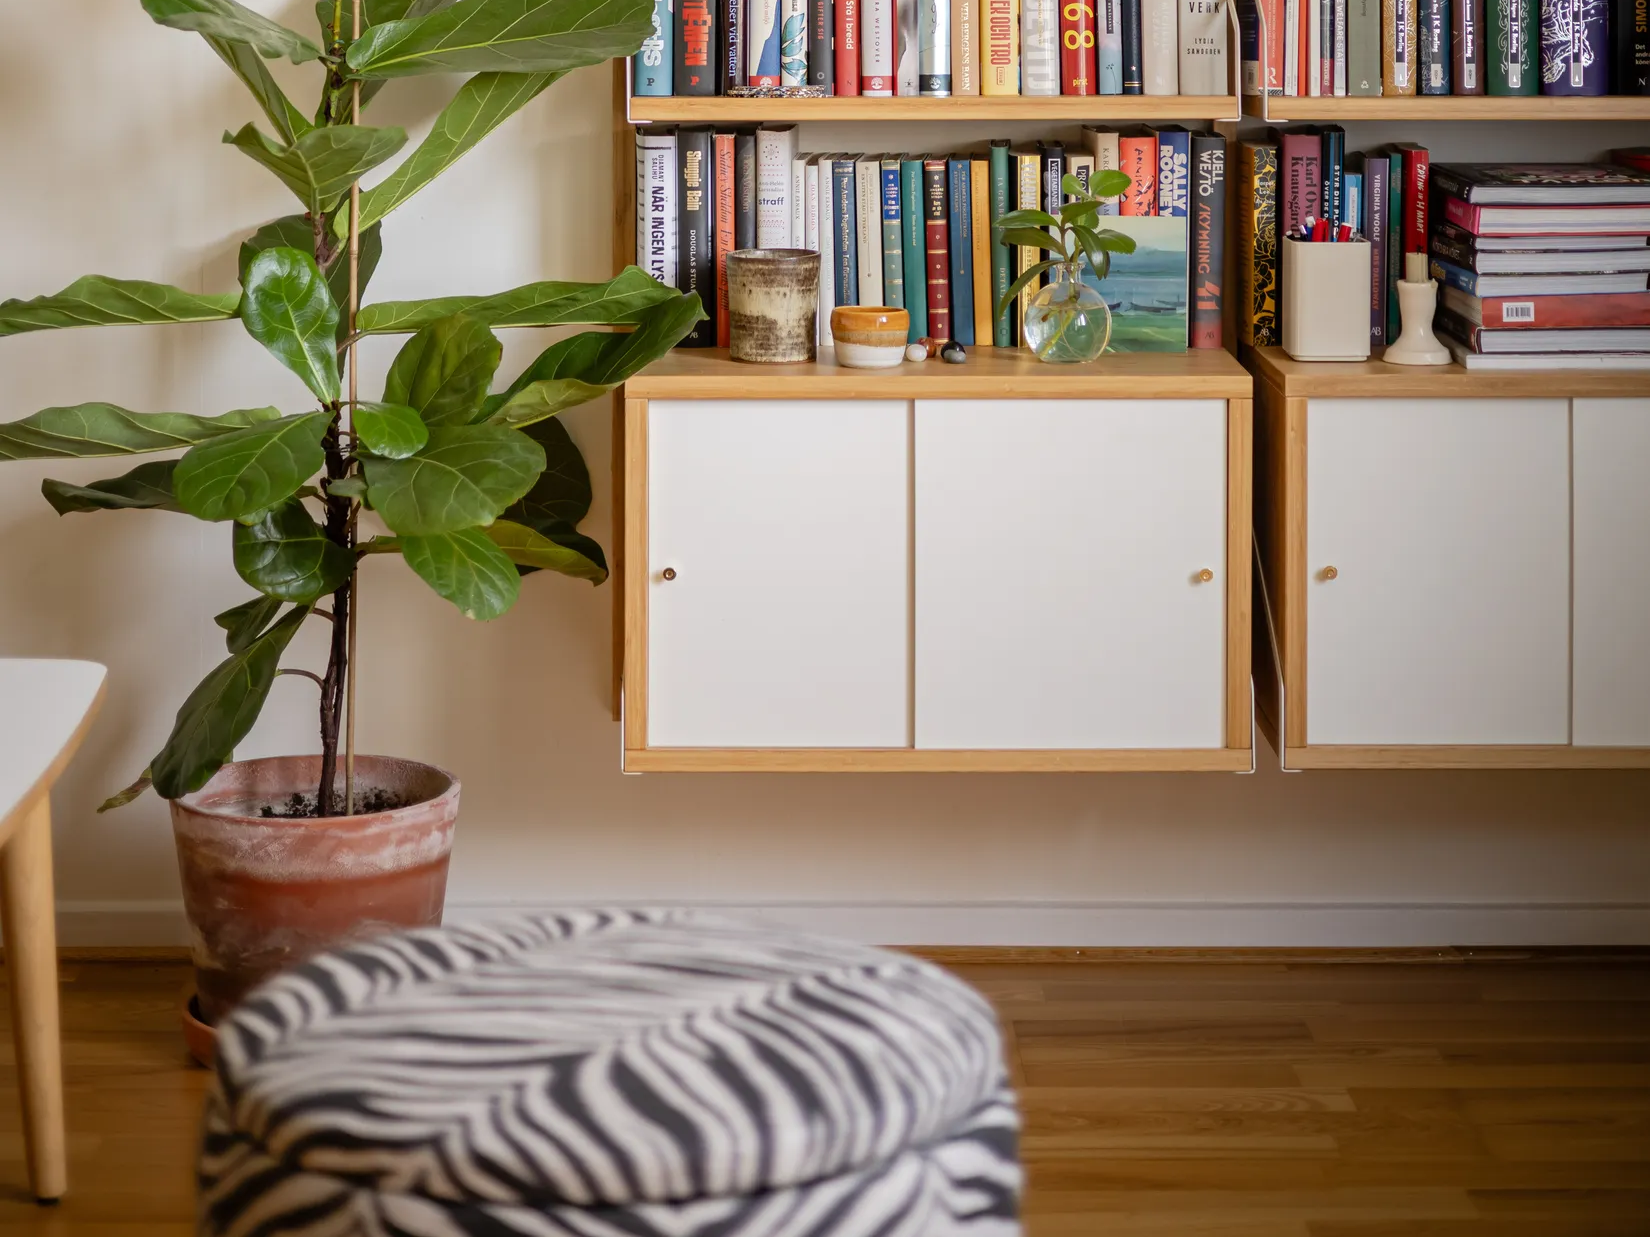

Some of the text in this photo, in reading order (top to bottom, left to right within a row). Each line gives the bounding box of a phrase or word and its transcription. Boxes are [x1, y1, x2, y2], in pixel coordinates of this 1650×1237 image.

[846, 1, 855, 15] Stå
[1189, 2, 1220, 14] VERK
[729, 26, 740, 42] vid
[846, 23, 855, 50] bredd
[990, 16, 1011, 40] OCH
[729, 44, 739, 77] vatten
[990, 43, 1011, 65] TRO
[684, 151, 702, 187] Shuggie
[1160, 145, 1173, 217] ROONEY
[1173, 153, 1187, 210] SALLY
[1199, 150, 1214, 196] WESTÖ
[1212, 150, 1224, 183] KJELL
[1305, 156, 1318, 187] Karl
[686, 190, 702, 210] Bain
[758, 196, 784, 205] straff
[1416, 164, 1426, 233] CRYING MART
[651, 186, 668, 255] NÄR INGEN
[1197, 202, 1220, 310] SKYMNING 41
